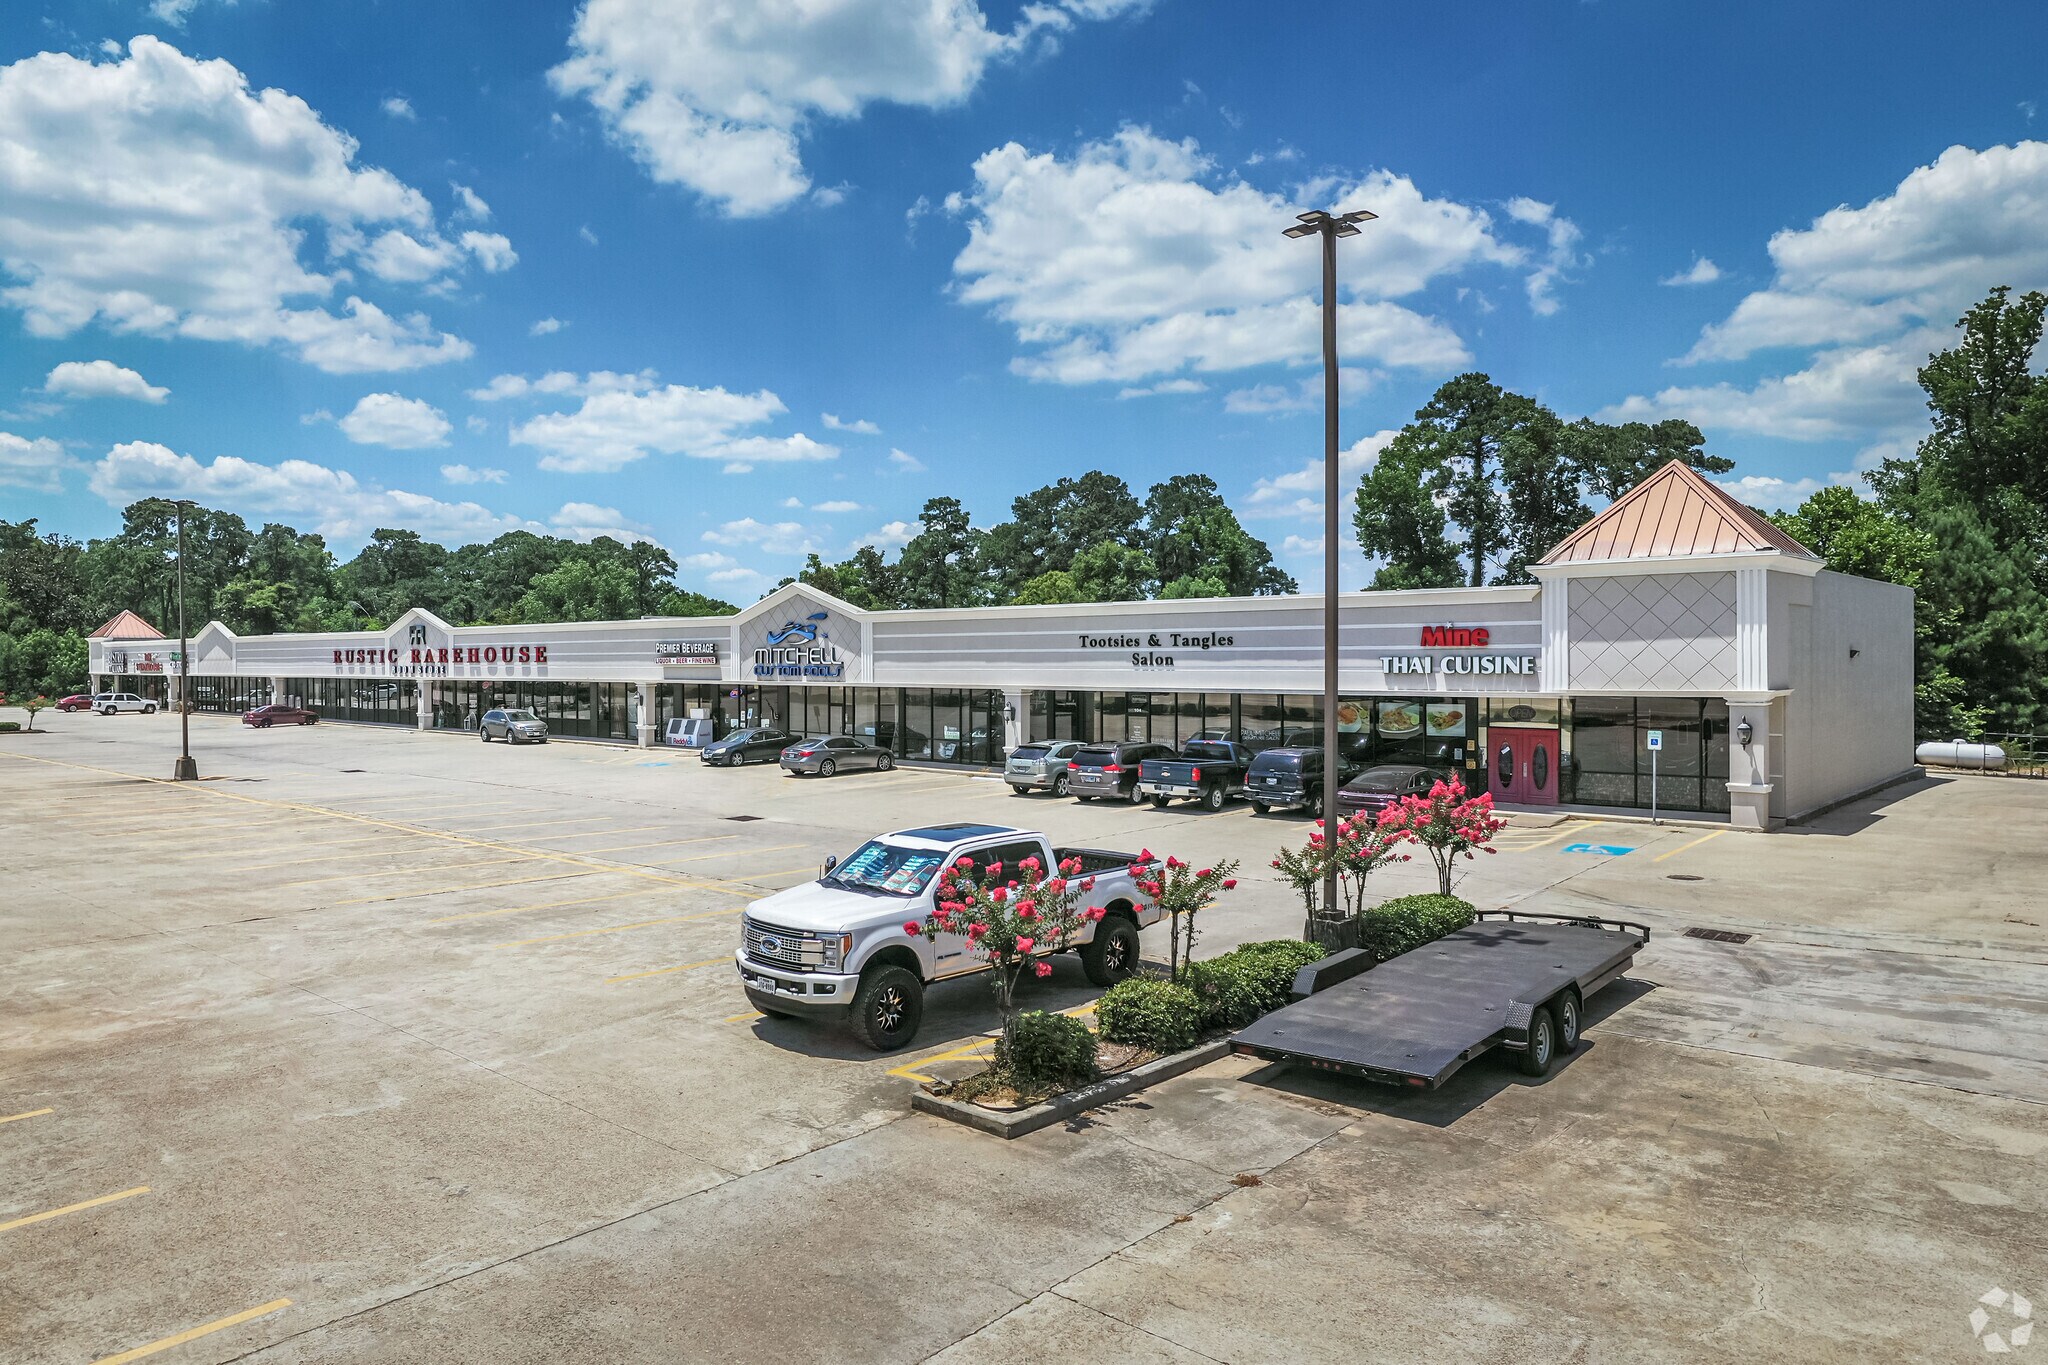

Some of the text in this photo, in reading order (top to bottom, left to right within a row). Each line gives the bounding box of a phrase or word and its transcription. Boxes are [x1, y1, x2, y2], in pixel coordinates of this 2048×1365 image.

[1079, 632, 1234, 650] Tootsies & Tangles
[1420, 622, 1490, 647] Mine
[333, 646, 548, 665] RUSTIC RAREHOUSE
[753, 647, 845, 666] MITCHELL
[1131, 652, 1175, 666] Salon
[391, 666, 447, 675] ROOM STORE
[1379, 656, 1536, 676] THAI CUISINE
